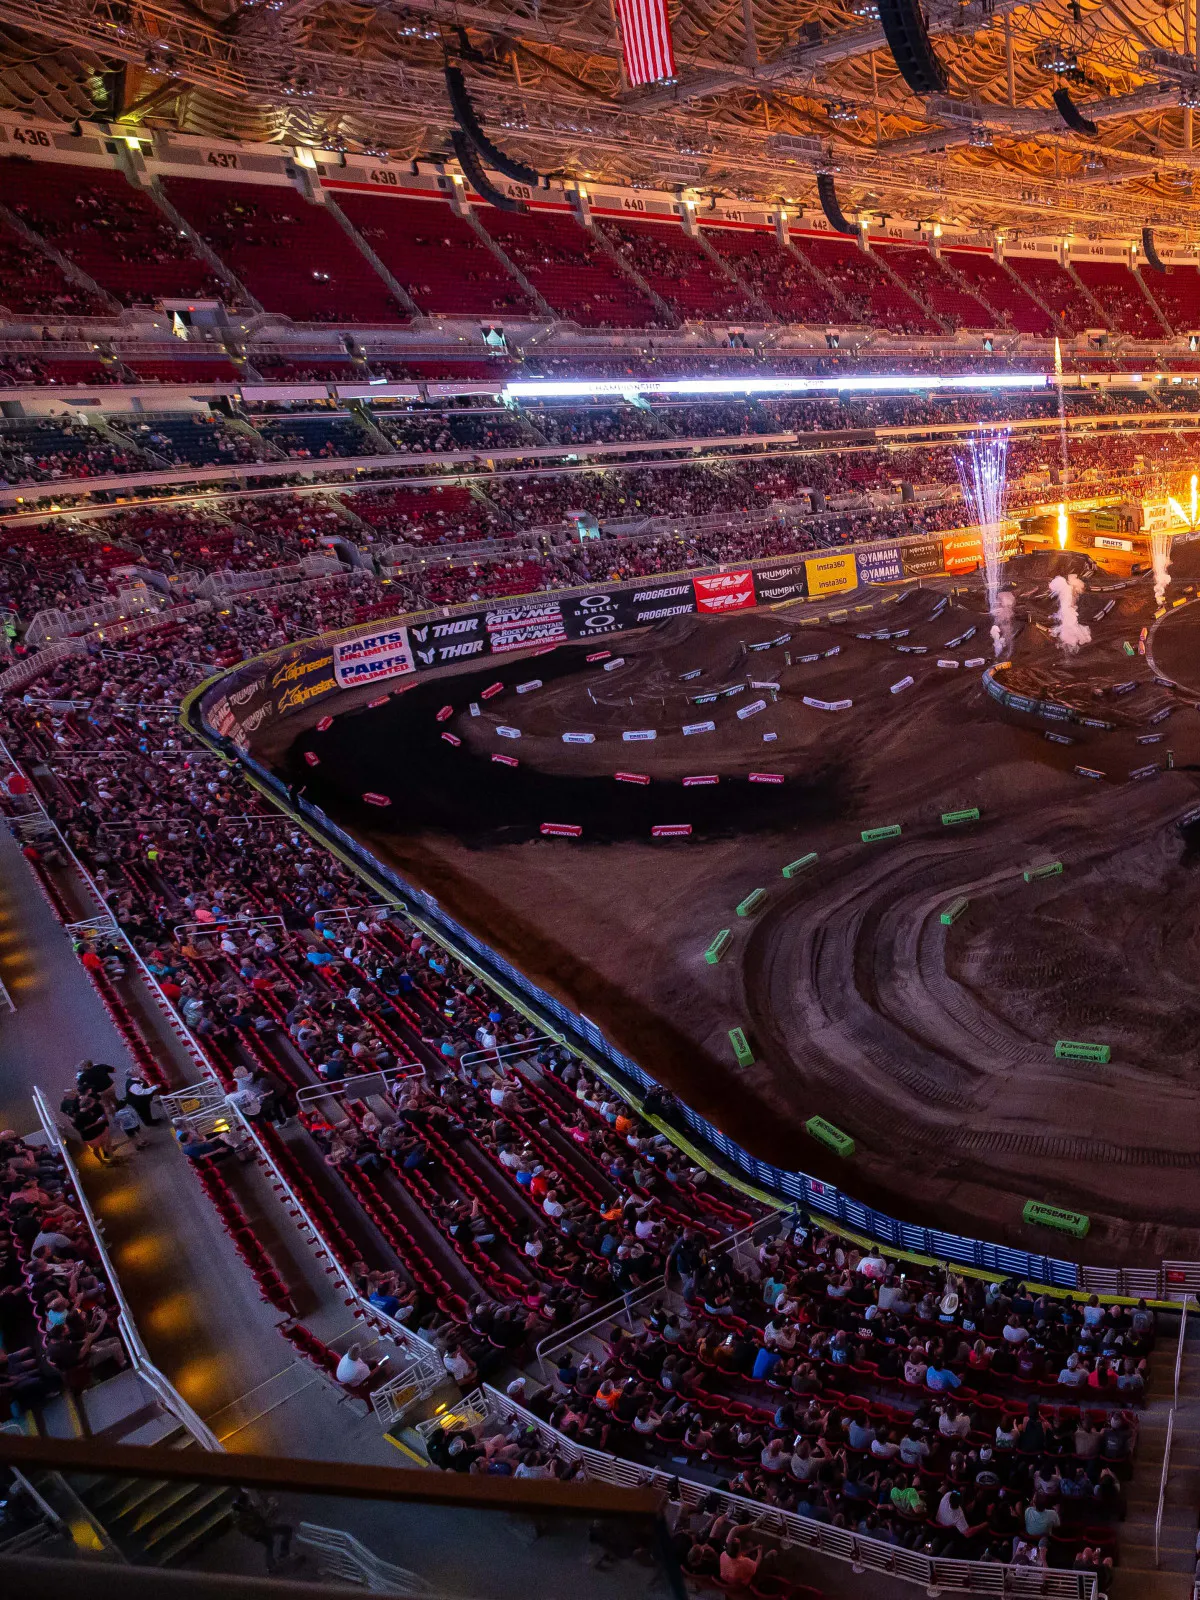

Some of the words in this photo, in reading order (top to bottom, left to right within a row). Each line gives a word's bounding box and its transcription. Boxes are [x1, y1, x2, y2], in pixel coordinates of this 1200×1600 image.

[13, 127, 50, 147] 436
[207, 152, 239, 169] 437
[369, 169, 397, 186] 438
[507, 183, 530, 199] 439
[624, 198, 644, 211] 440
[725, 210, 743, 222] 441
[812, 219, 828, 231] 442
[1022, 241, 1036, 251] 445
[1160, 249, 1174, 258] 447
[953, 539, 981, 549] HONDA
[1102, 539, 1123, 547] PARTS
[867, 549, 898, 564] YAMAHA
[954, 555, 983, 565] HONDA
[816, 560, 846, 572] Insta360
[869, 564, 900, 579] YAMAHA
[702, 573, 750, 589] FLY
[757, 568, 793, 580] TRIUMPH
[818, 577, 848, 589] Insta360
[633, 584, 691, 603] PROGRESSIVE
[705, 591, 753, 607] FLY
[759, 585, 795, 598] TRIUMPH
[497, 606, 521, 615] ROCKY
[522, 601, 559, 611] MOUNTAIN
[574, 603, 620, 616] OAKLEY
[637, 603, 694, 622] PROGRESSIVE
[432, 618, 479, 638] THOR
[501, 627, 525, 637] ROCKY
[525, 621, 563, 633] MOUNTAIN
[580, 623, 624, 636] OAKLEY
[339, 632, 401, 655] PARTS
[439, 639, 484, 660] THOR
[339, 641, 403, 662] UNLIMITED
[341, 654, 407, 678] PARTS
[344, 662, 409, 685] UNLIMITED
[229, 681, 259, 706] TRIUMPH
[293, 678, 338, 705] alpinestars
[730, 686, 745, 695] UFO
[700, 695, 717, 703] UFO
[241, 707, 267, 732] TRIUMPH
[867, 829, 898, 839] Kawasaki
[1060, 1042, 1103, 1052] Kawasaki
[1060, 1051, 1102, 1061] Kawasaki
[1031, 1204, 1081, 1225] Kawasaki
